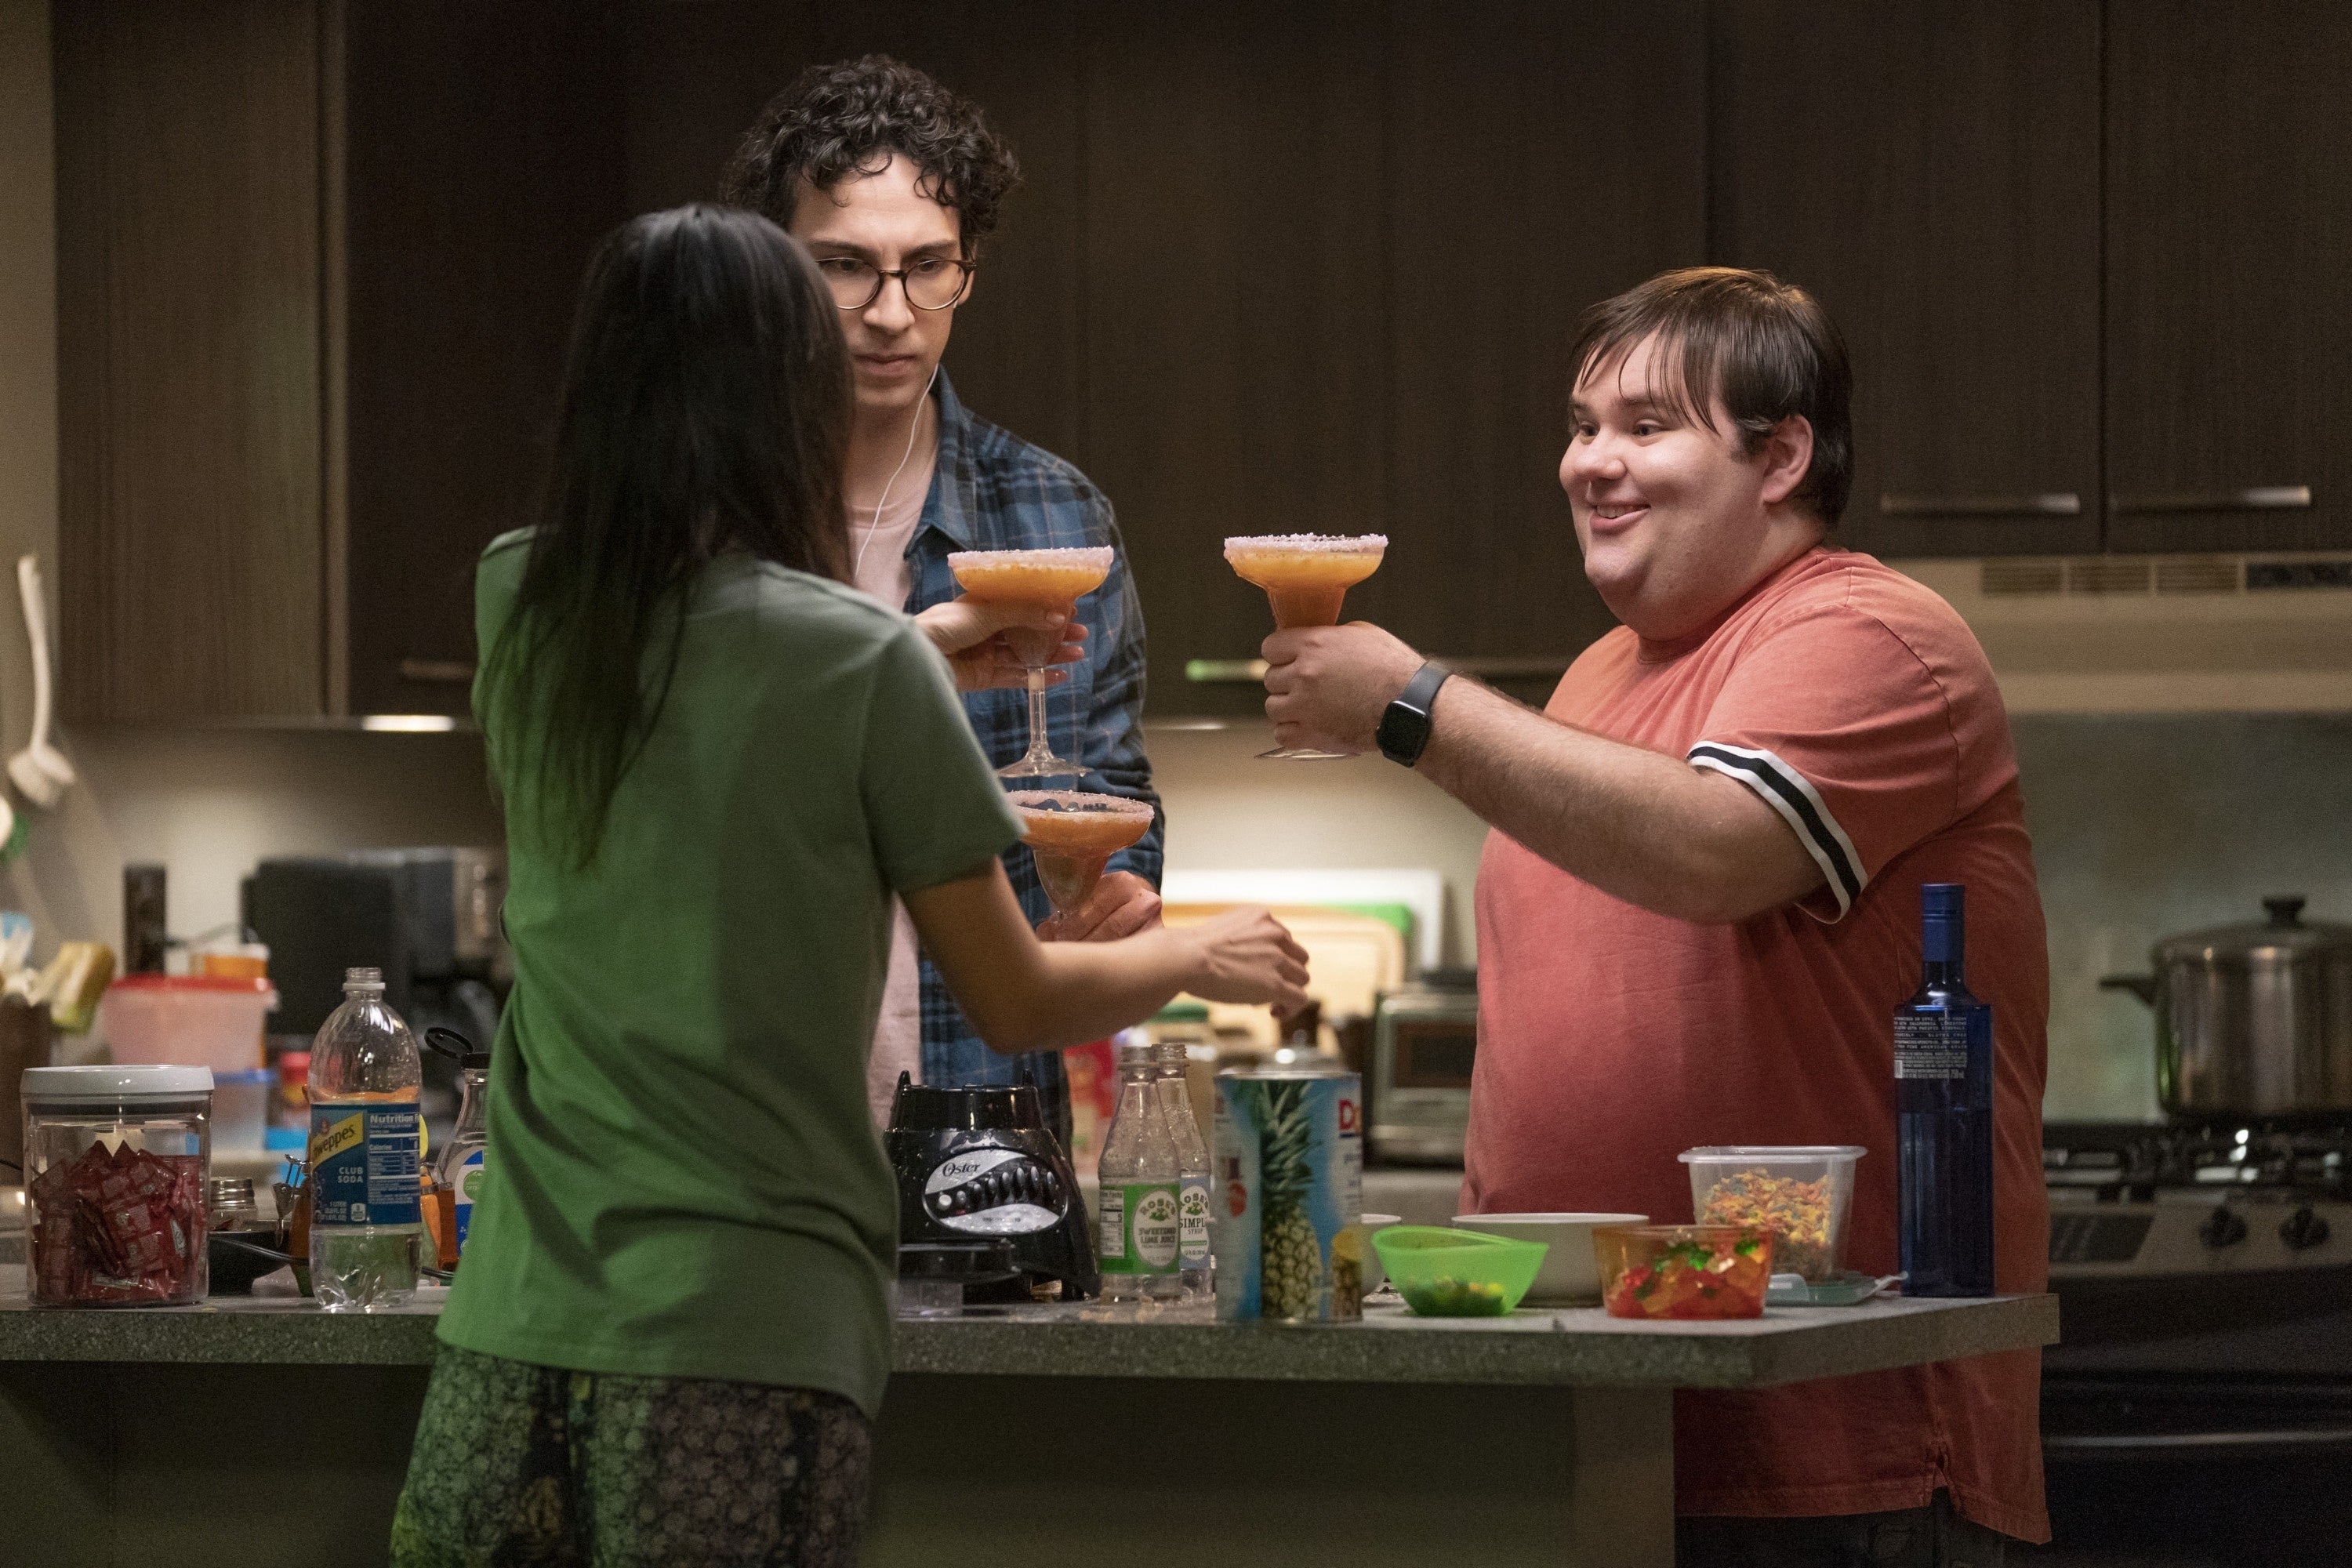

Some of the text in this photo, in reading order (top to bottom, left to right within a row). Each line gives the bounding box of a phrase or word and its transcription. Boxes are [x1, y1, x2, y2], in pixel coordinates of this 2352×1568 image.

[369, 1113, 413, 1123] Nutrition
[942, 1162, 980, 1177] Oster
[337, 1175, 364, 1184] SODA
[1139, 1198, 1175, 1216] ROSE'S
[1179, 1218, 1208, 1229] SIMPL
